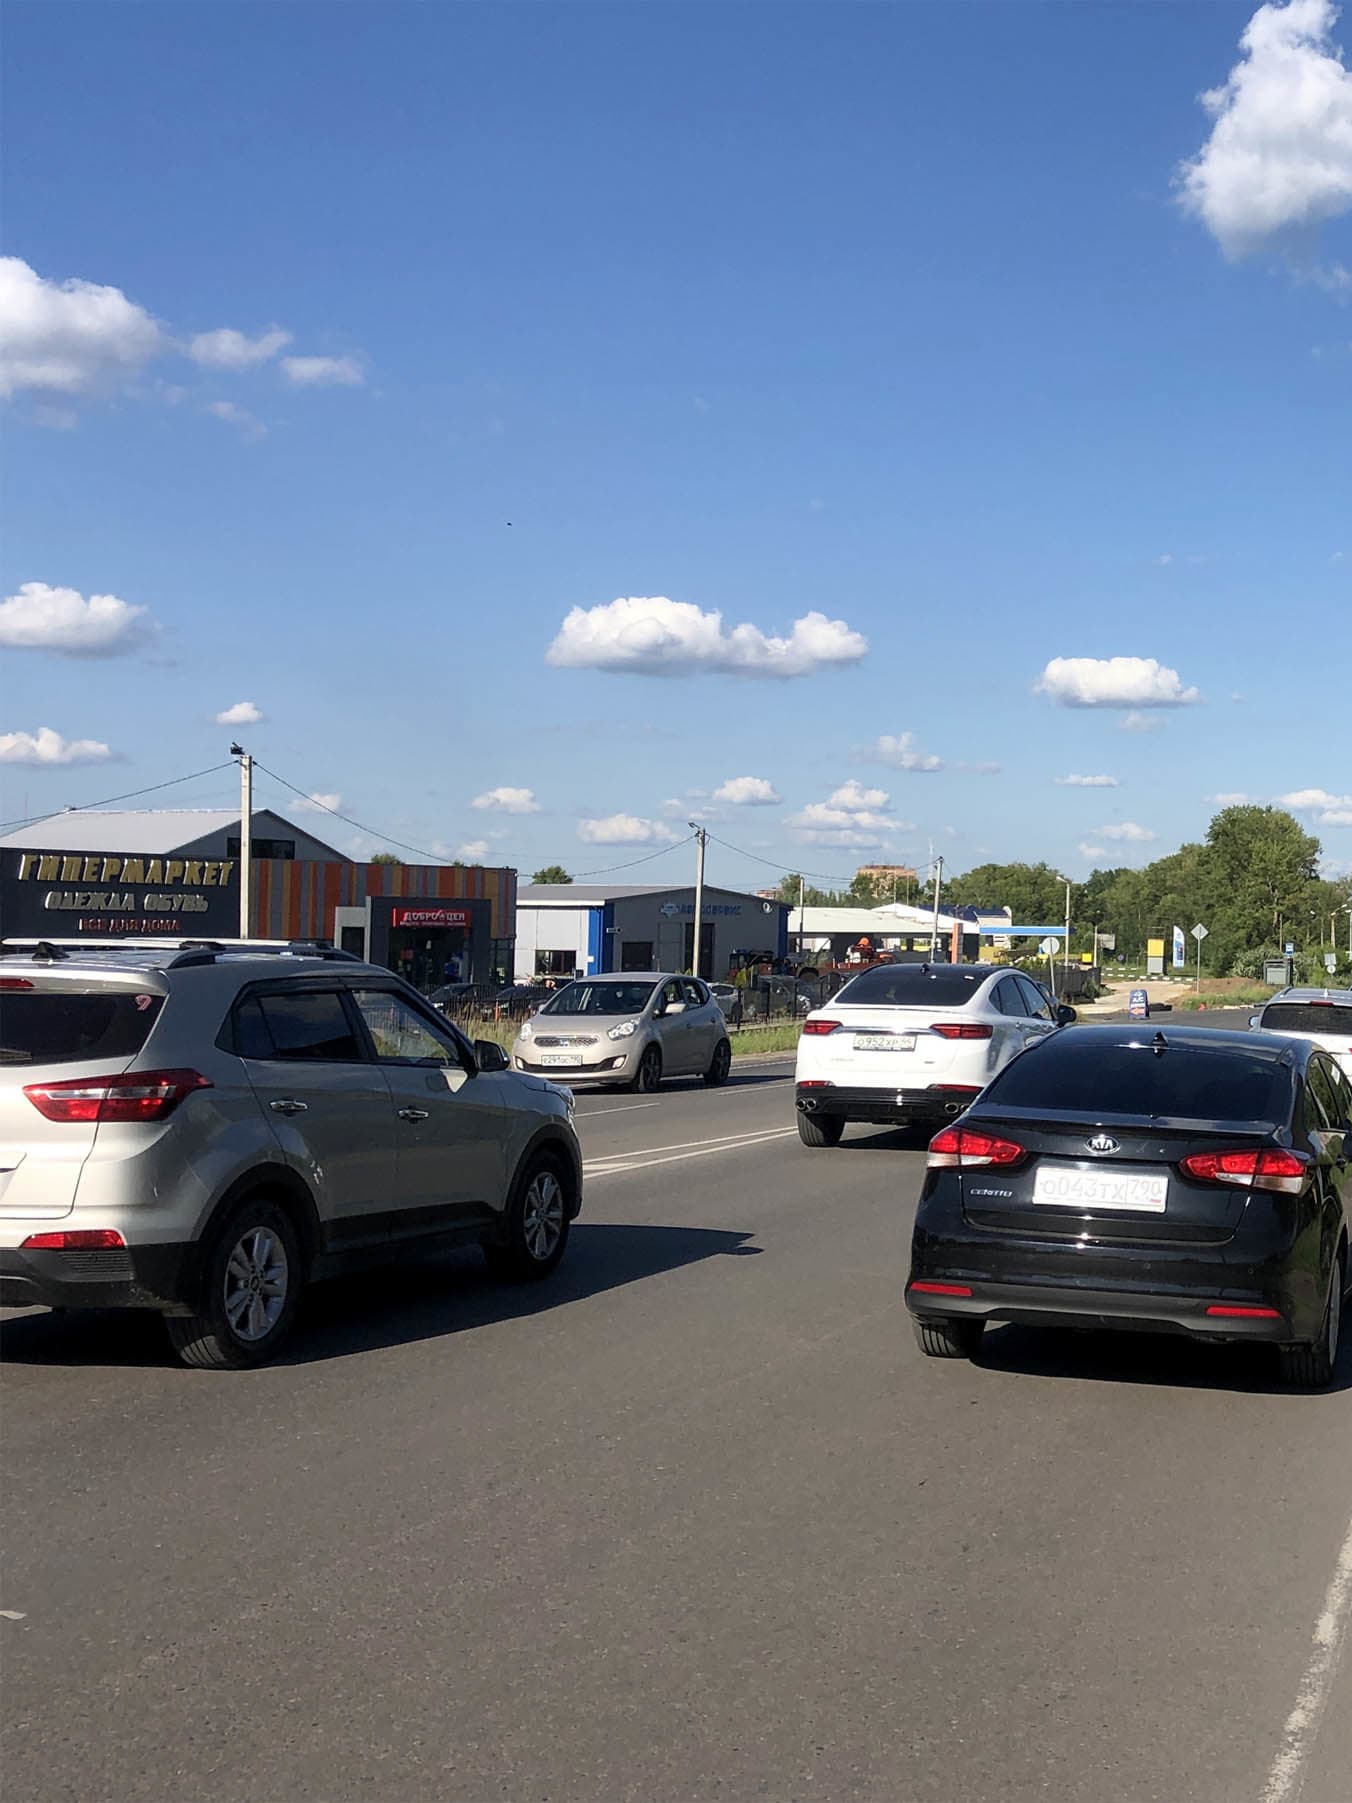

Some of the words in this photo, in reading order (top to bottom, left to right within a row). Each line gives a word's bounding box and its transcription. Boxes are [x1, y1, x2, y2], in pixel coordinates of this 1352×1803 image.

[18, 853, 234, 886] ГИПЕРМАРКЕТ
[44, 890, 136, 911] ОДЕЖДА
[143, 893, 209, 912] ОБУВЬ
[679, 903, 742, 916] АВОСЕРВИС
[109, 919, 139, 932] ДЛЯ
[141, 919, 182, 932] ДОМА
[1091, 1137, 1114, 1150] KIA
